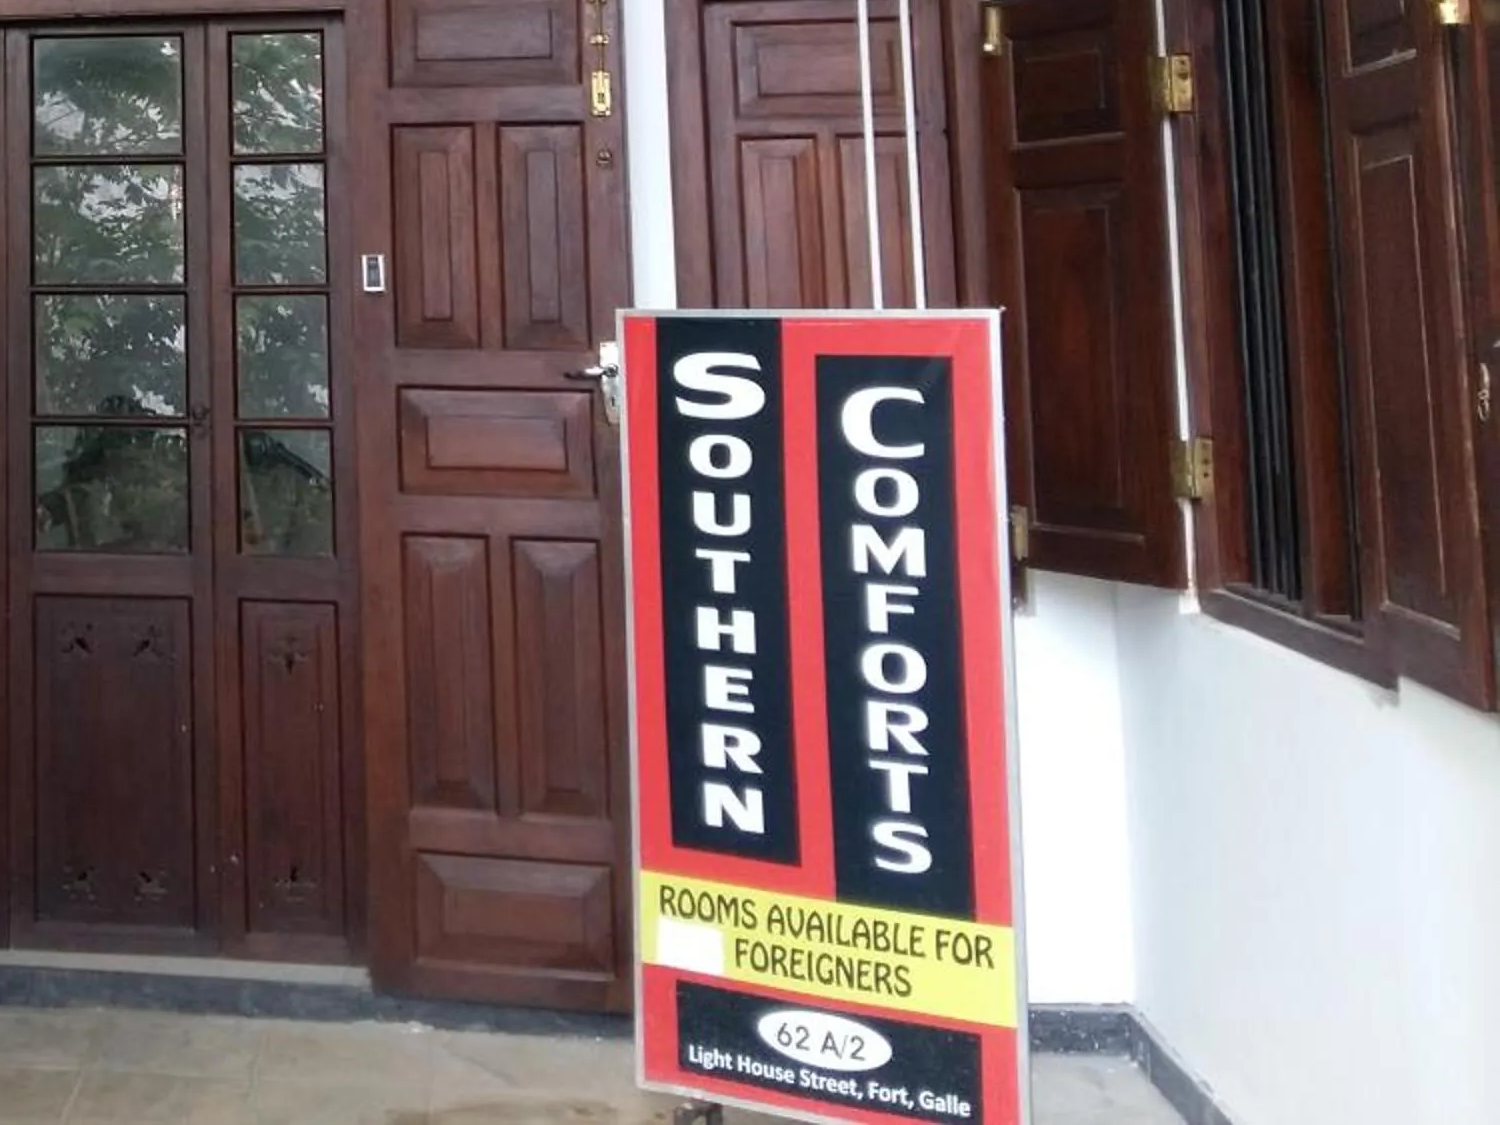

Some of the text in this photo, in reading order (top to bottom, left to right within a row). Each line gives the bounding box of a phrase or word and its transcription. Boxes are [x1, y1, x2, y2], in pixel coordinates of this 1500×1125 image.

[673, 351, 767, 834] SOUTHERN
[840, 386, 934, 873] COMFORTS
[659, 884, 995, 969] ROOMS AVAILABLE FOR
[734, 938, 912, 997] FOREIGNERS
[688, 1045, 971, 1118] Light House Street, Fort, Galle
[776, 1022, 866, 1062] 62 A/2
